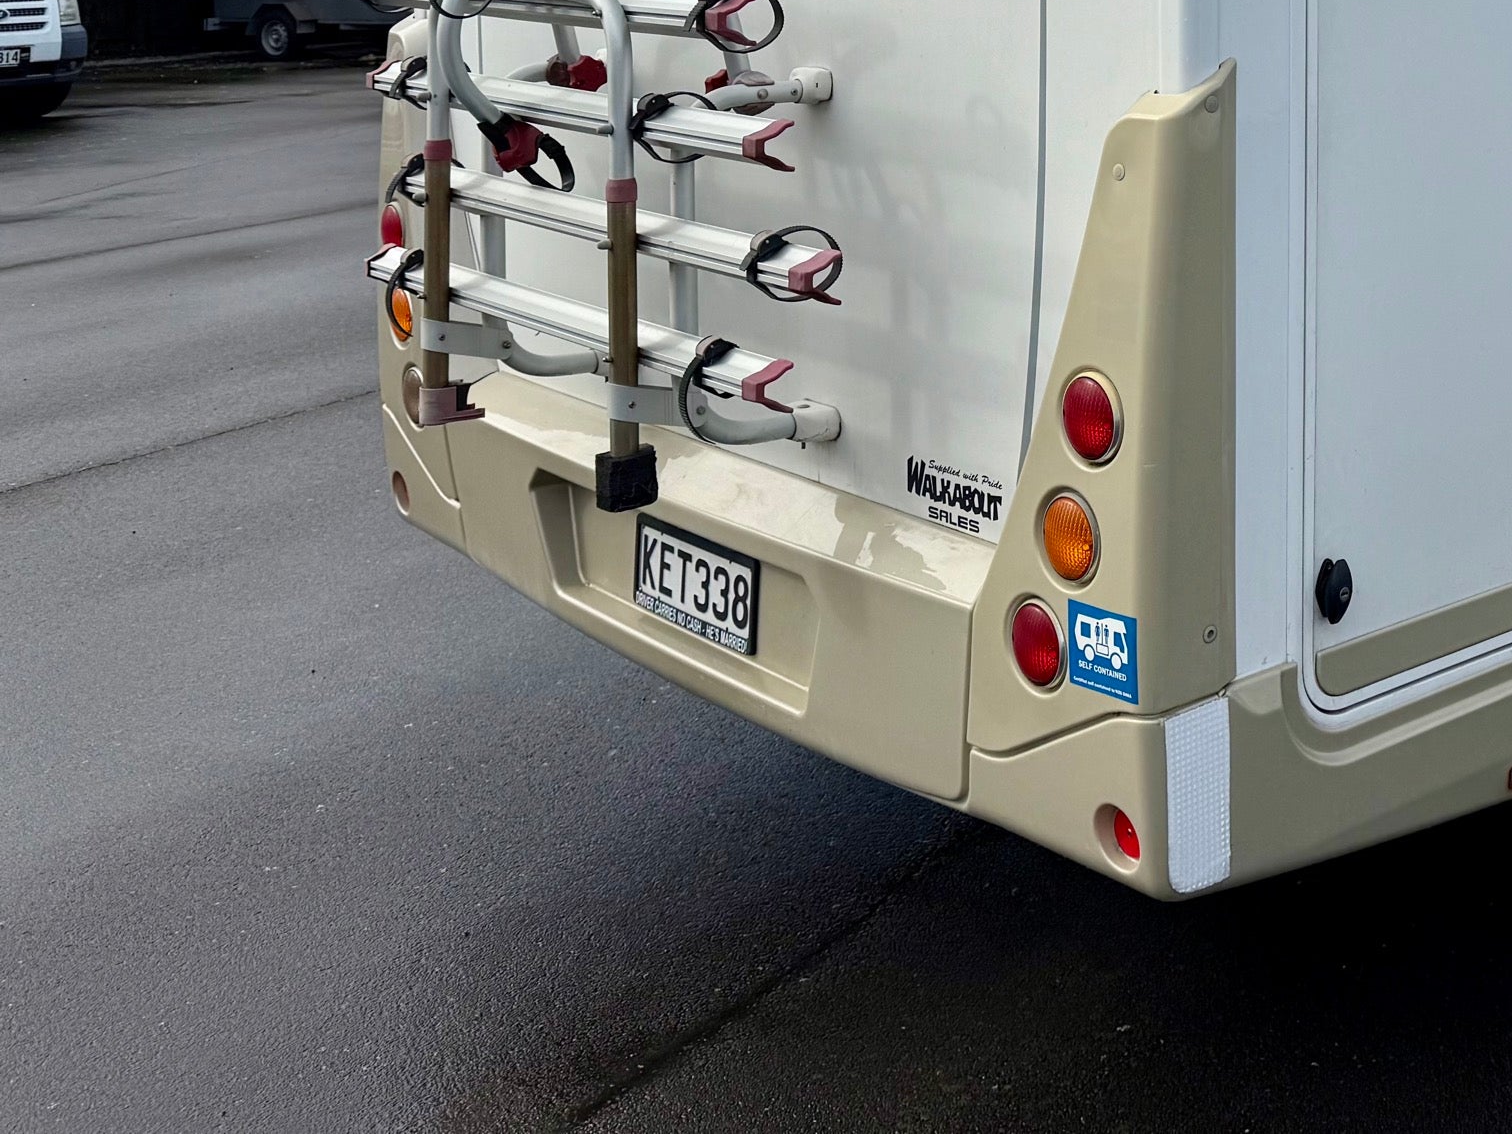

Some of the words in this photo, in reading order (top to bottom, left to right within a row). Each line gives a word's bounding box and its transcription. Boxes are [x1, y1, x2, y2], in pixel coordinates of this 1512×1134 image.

[907, 455, 1003, 522] WALKABOUT
[928, 459, 961, 478] Supplied
[962, 472, 979, 483] with
[981, 474, 1003, 490] Pride
[928, 506, 980, 534] SALES
[642, 533, 750, 631] KET338
[635, 590, 655, 612] DRIVER
[655, 599, 677, 623] CARRIES
[677, 610, 686, 626] NO
[686, 615, 702, 634] CASH
[705, 624, 720, 644] HE'S
[1078, 659, 1093, 671] SELF
[1093, 664, 1127, 682] CONTAINED
